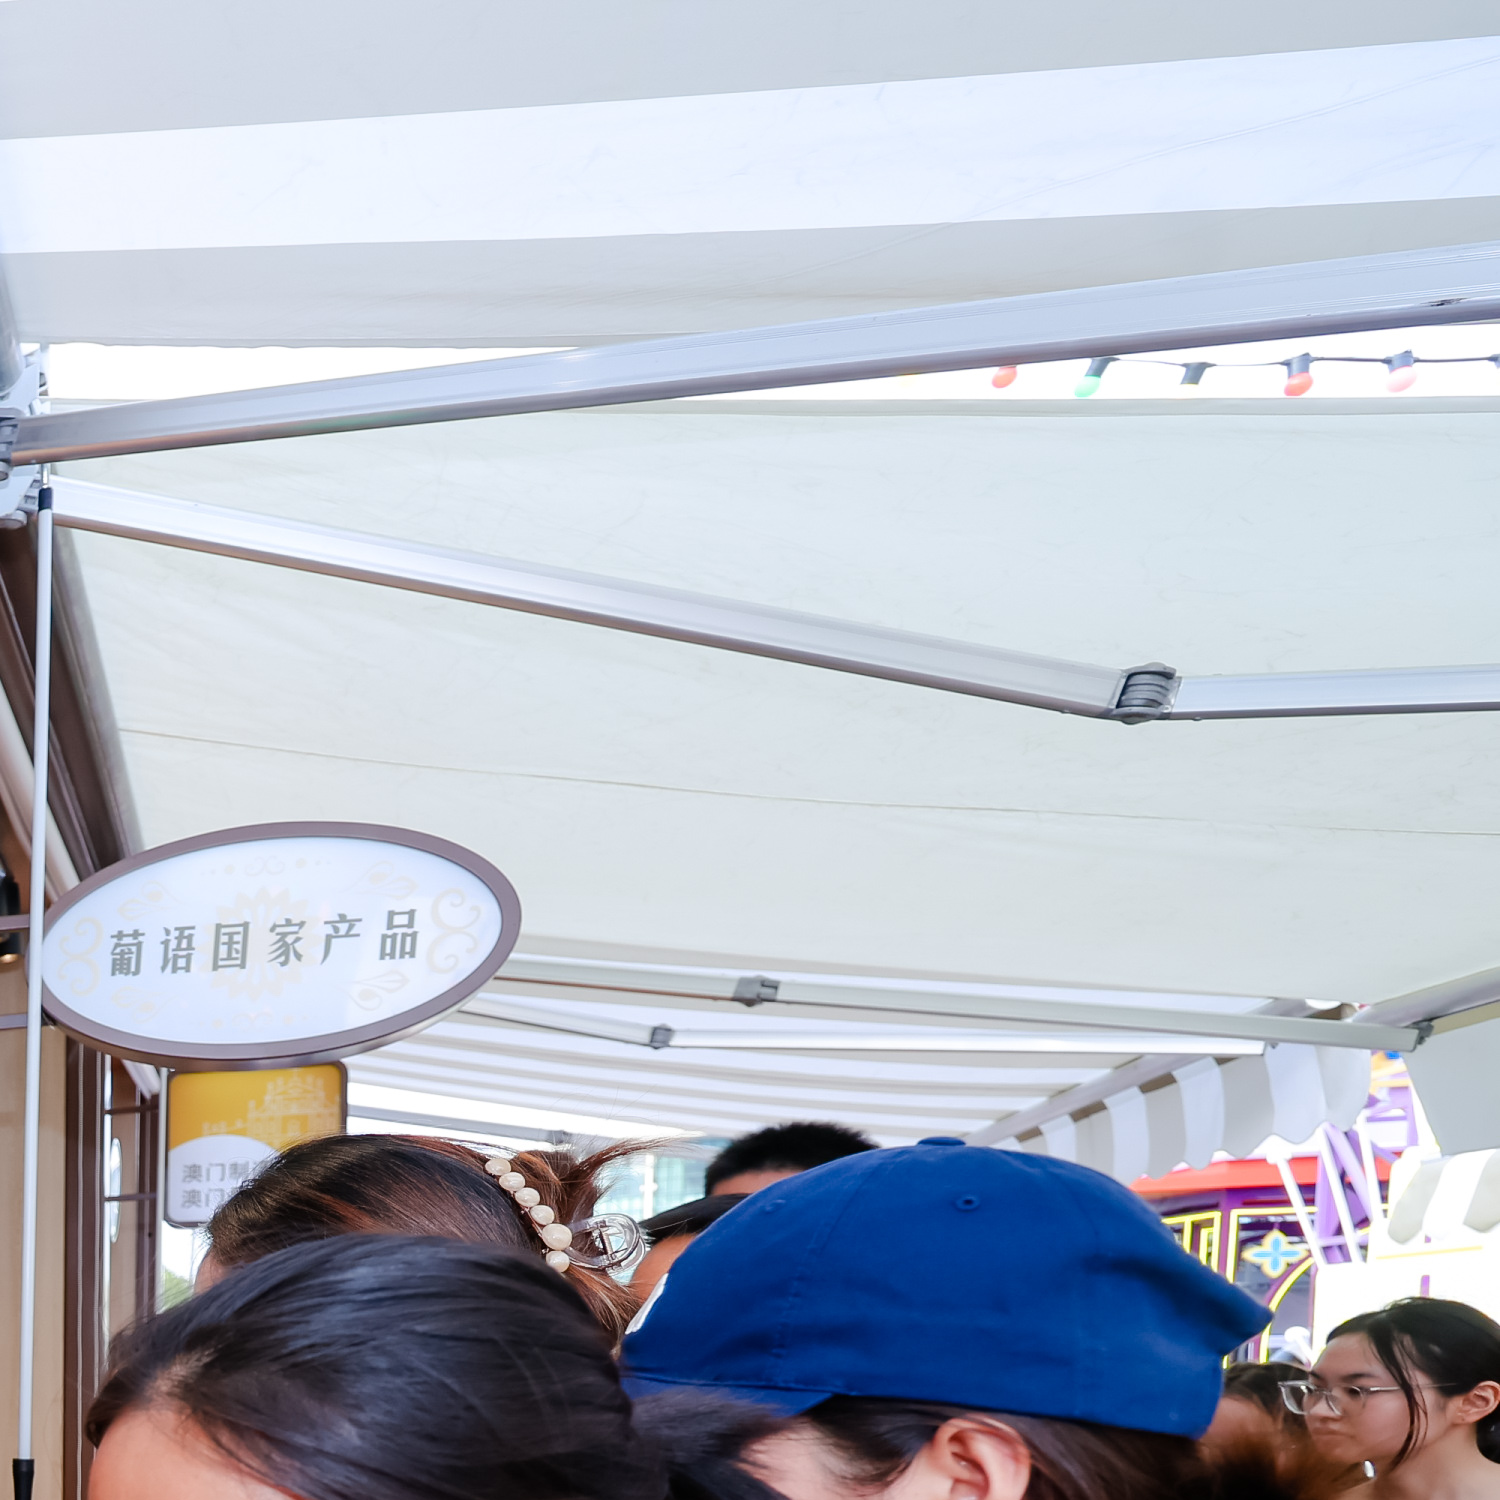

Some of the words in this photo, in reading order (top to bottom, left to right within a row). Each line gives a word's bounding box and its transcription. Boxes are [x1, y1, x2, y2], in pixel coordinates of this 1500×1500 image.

[109, 907, 419, 978] 葡语国家产品
